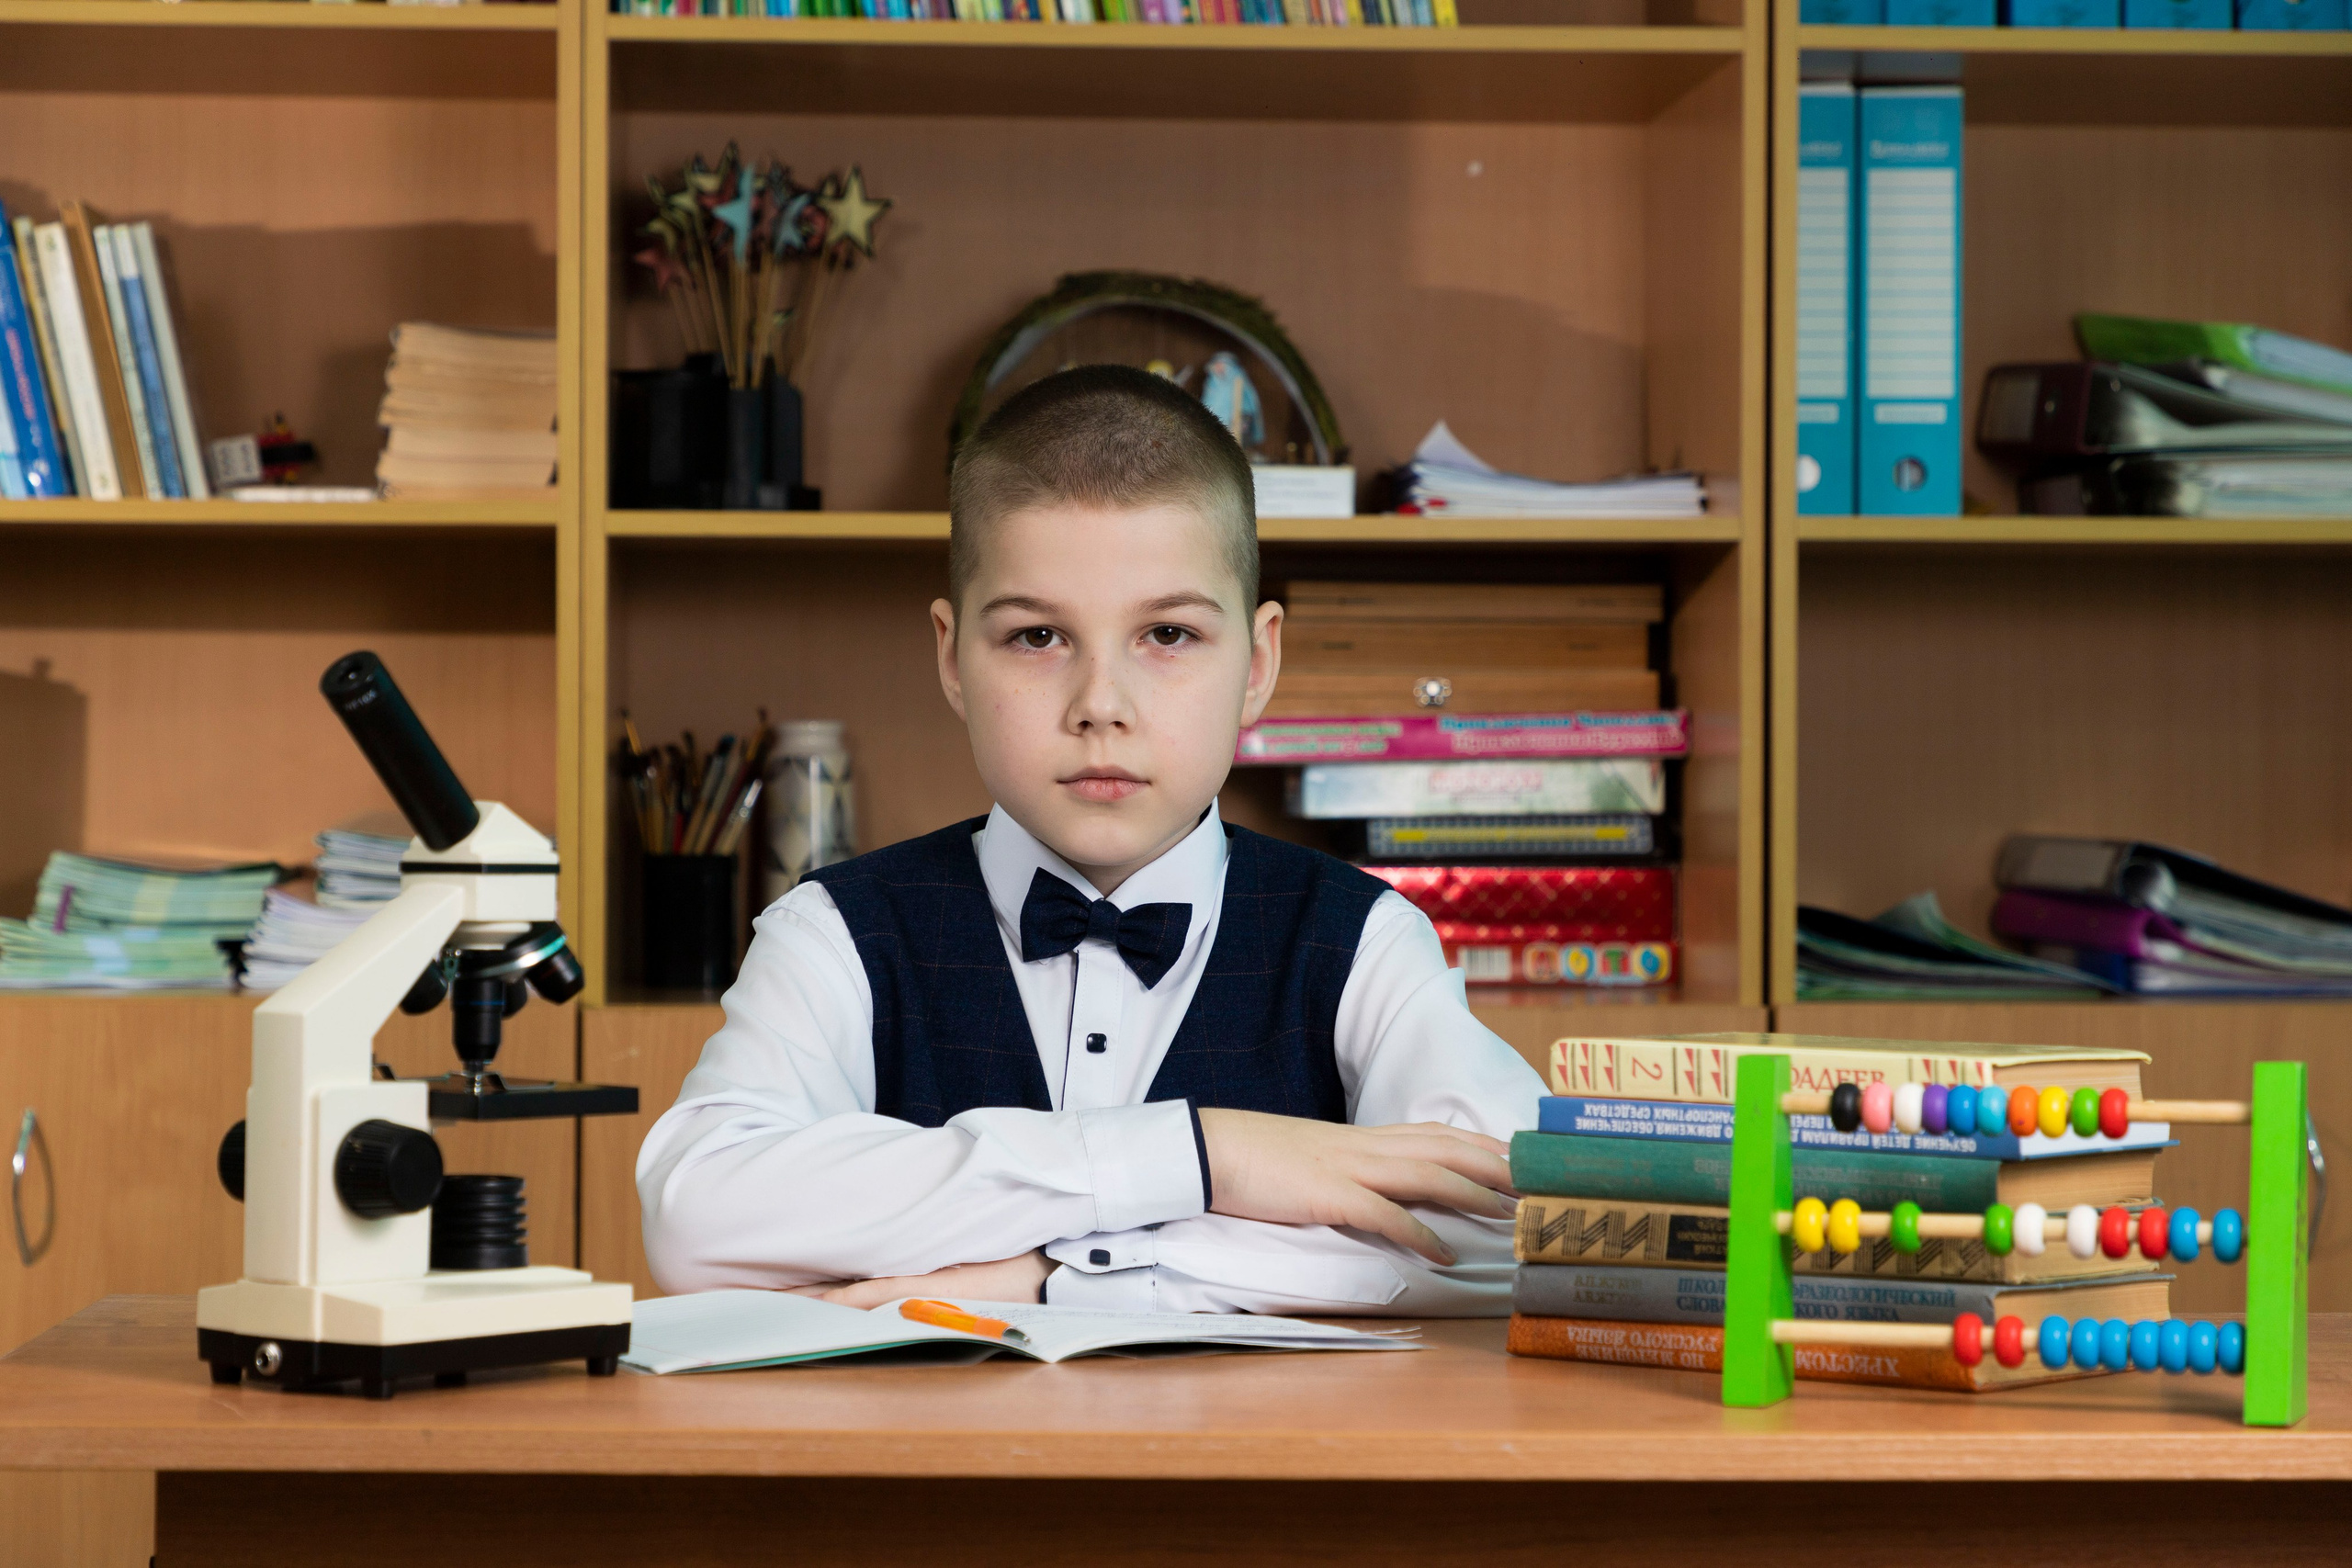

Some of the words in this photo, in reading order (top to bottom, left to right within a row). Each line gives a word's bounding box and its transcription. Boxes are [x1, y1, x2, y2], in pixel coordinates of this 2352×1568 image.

[1631, 1056, 1664, 1081] 2
[1583, 1102, 1651, 1120] СРЕДСТВАХ
[1654, 1107, 1736, 1124] РАНСПОРТНЫХ
[1575, 1117, 1654, 1134] ОБЕСПЕЧЕНИЕ
[1801, 1129, 1870, 1147] ПРАВИЛАМ
[1871, 1133, 1911, 1150] ДЕТЕЙ
[1915, 1135, 1977, 1154] ОБУЧЕНИЕ
[1677, 1275, 1726, 1294] ШКОЛ
[1566, 1325, 1626, 1347] ЯЗЫКА
[1629, 1330, 1719, 1353] РУССКОГО
[1576, 1344, 1675, 1367] МЕТОДИКЕ
[1679, 1352, 1707, 1370] ПО
[1794, 1348, 1901, 1378] ХРЕСТОМ
